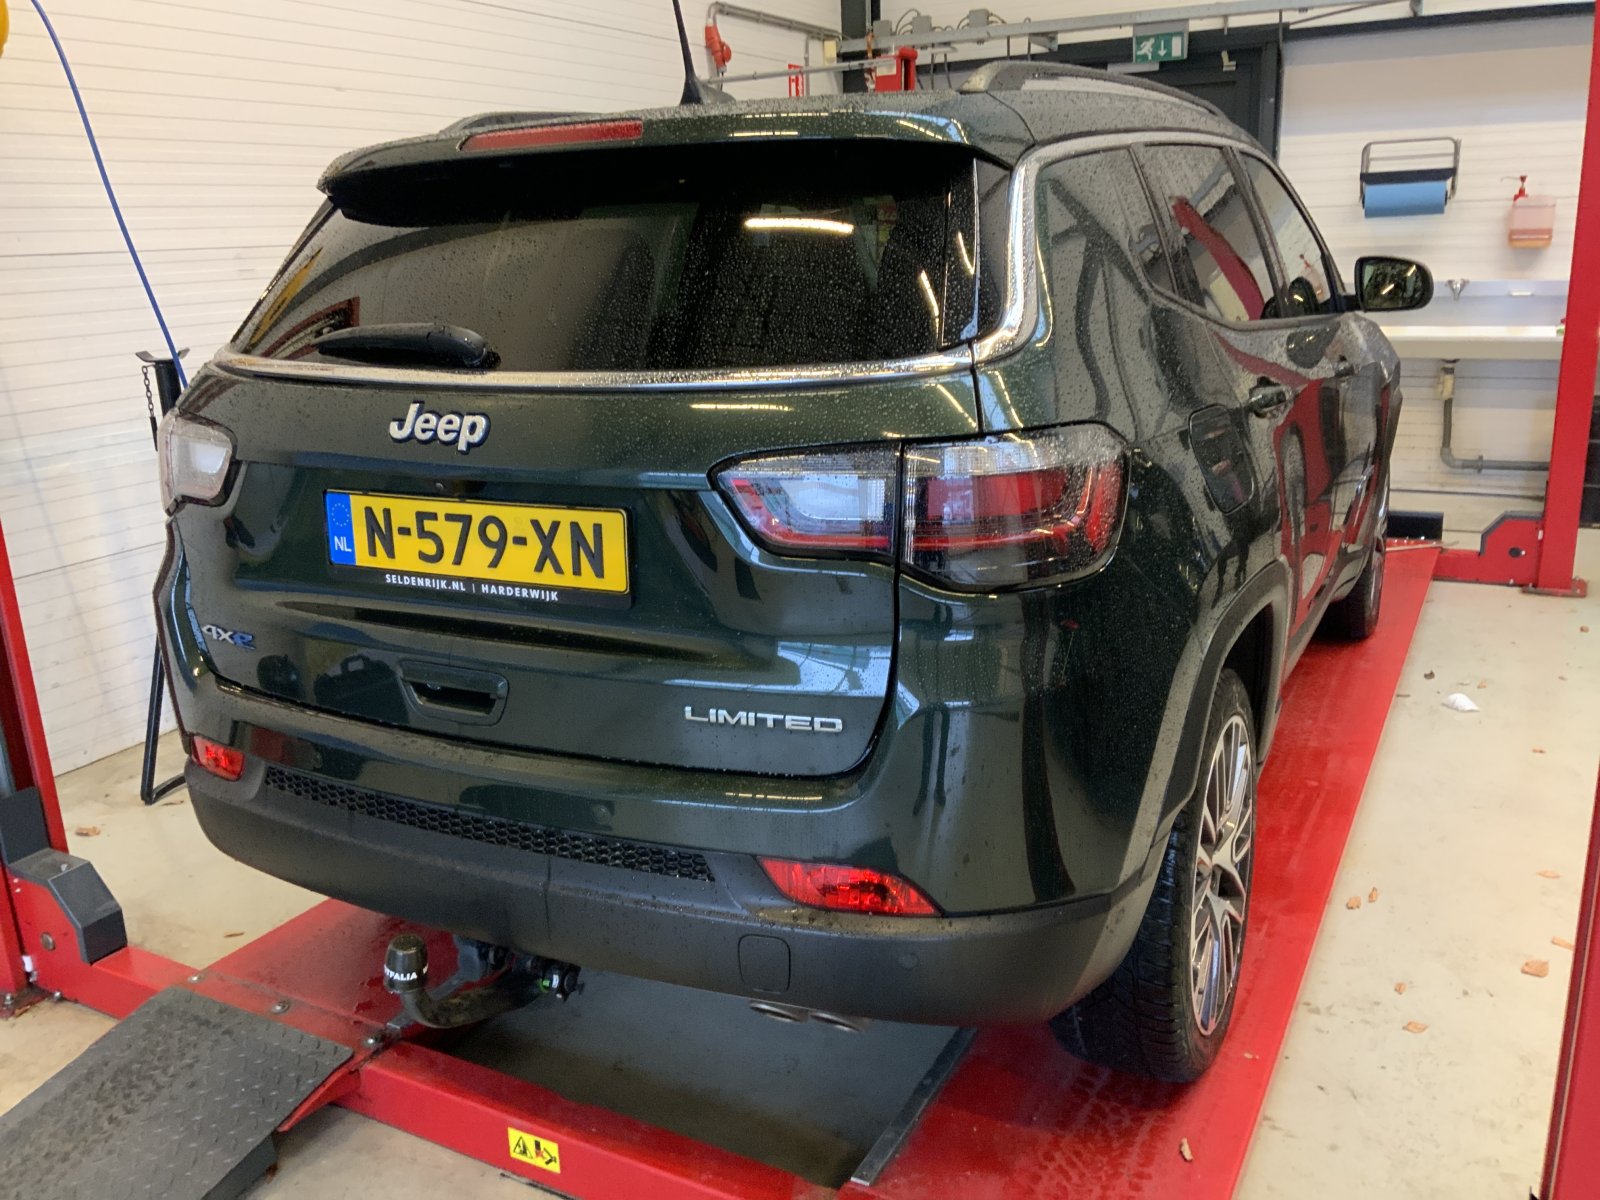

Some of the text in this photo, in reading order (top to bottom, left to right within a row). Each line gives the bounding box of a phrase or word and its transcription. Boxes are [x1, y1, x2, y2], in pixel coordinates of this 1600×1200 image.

[389, 402, 489, 453] Jeep
[334, 535, 352, 552] NL
[364, 506, 605, 579] N-579-XN
[385, 573, 559, 601] SELDENRIJK.NL HARDERWIJK
[685, 706, 843, 733] LIMITED
